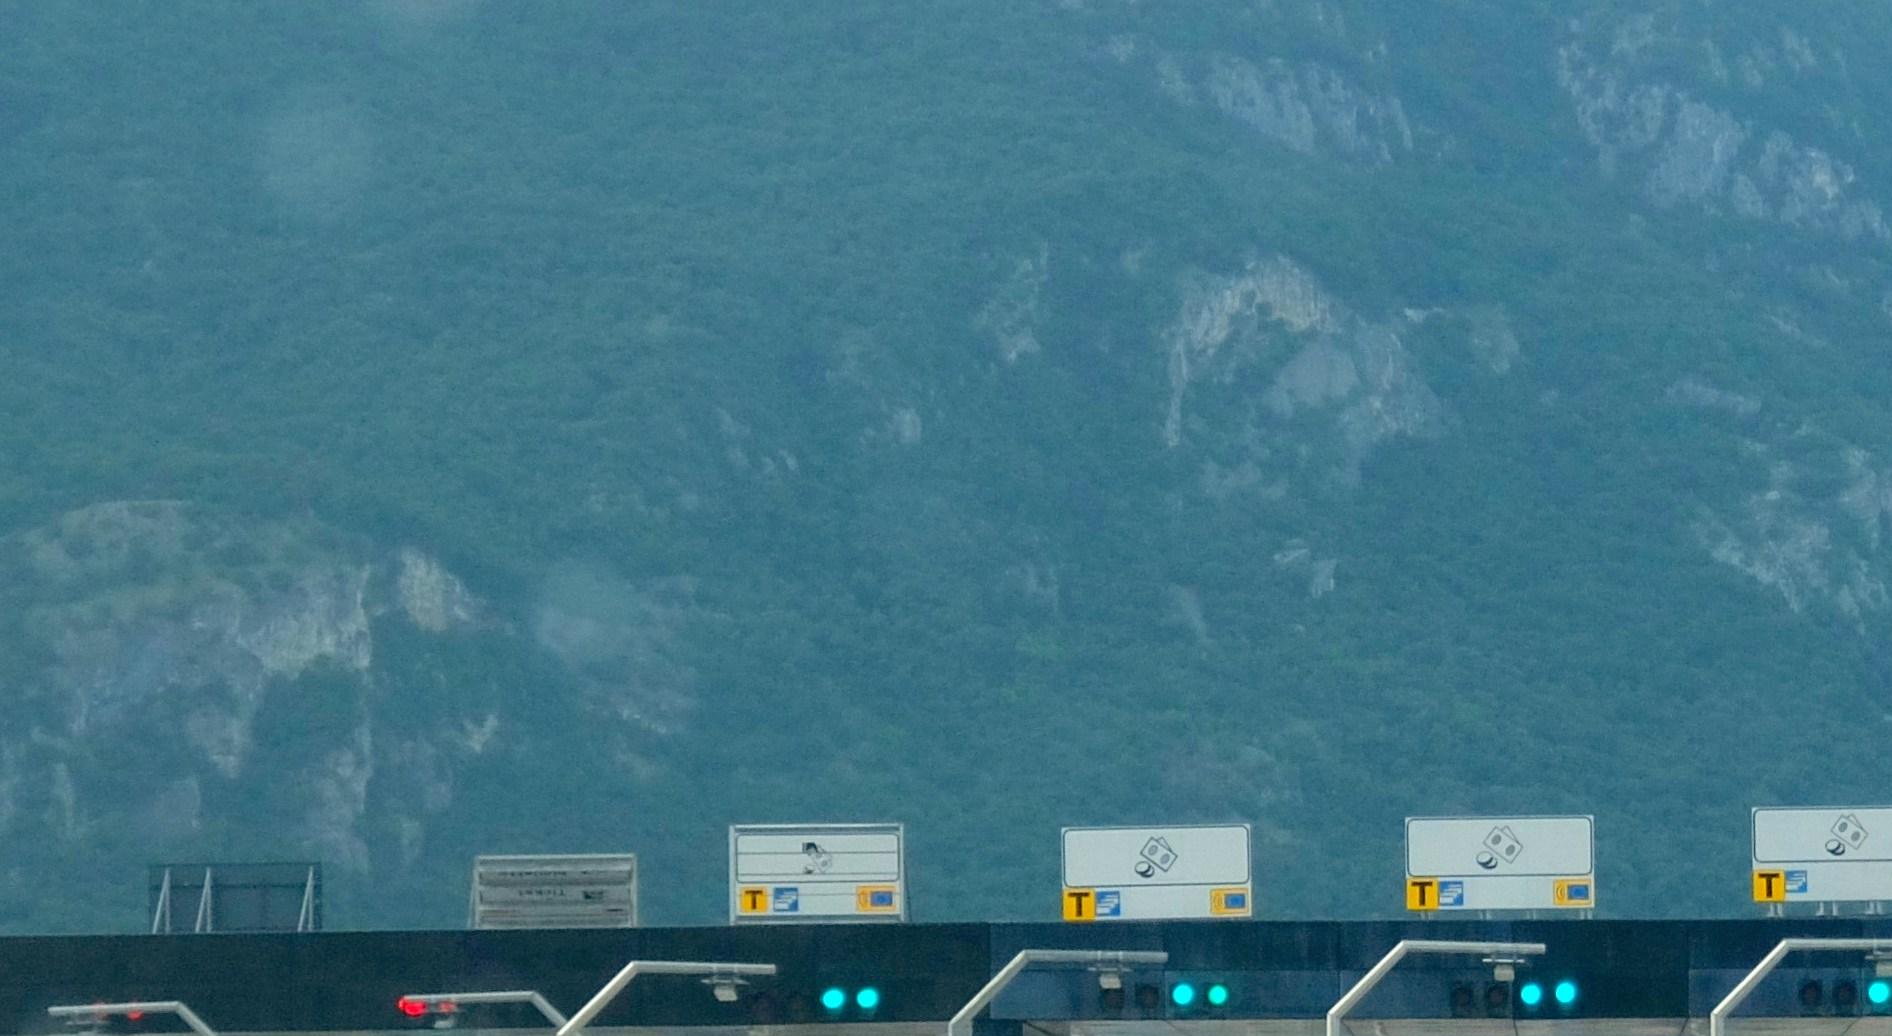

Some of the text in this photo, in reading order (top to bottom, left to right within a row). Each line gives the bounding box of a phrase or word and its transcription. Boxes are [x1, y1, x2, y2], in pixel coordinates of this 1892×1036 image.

[1411, 881, 1433, 906] T
[1758, 873, 1780, 898] T
[745, 890, 763, 910] T
[1068, 892, 1090, 917] T
